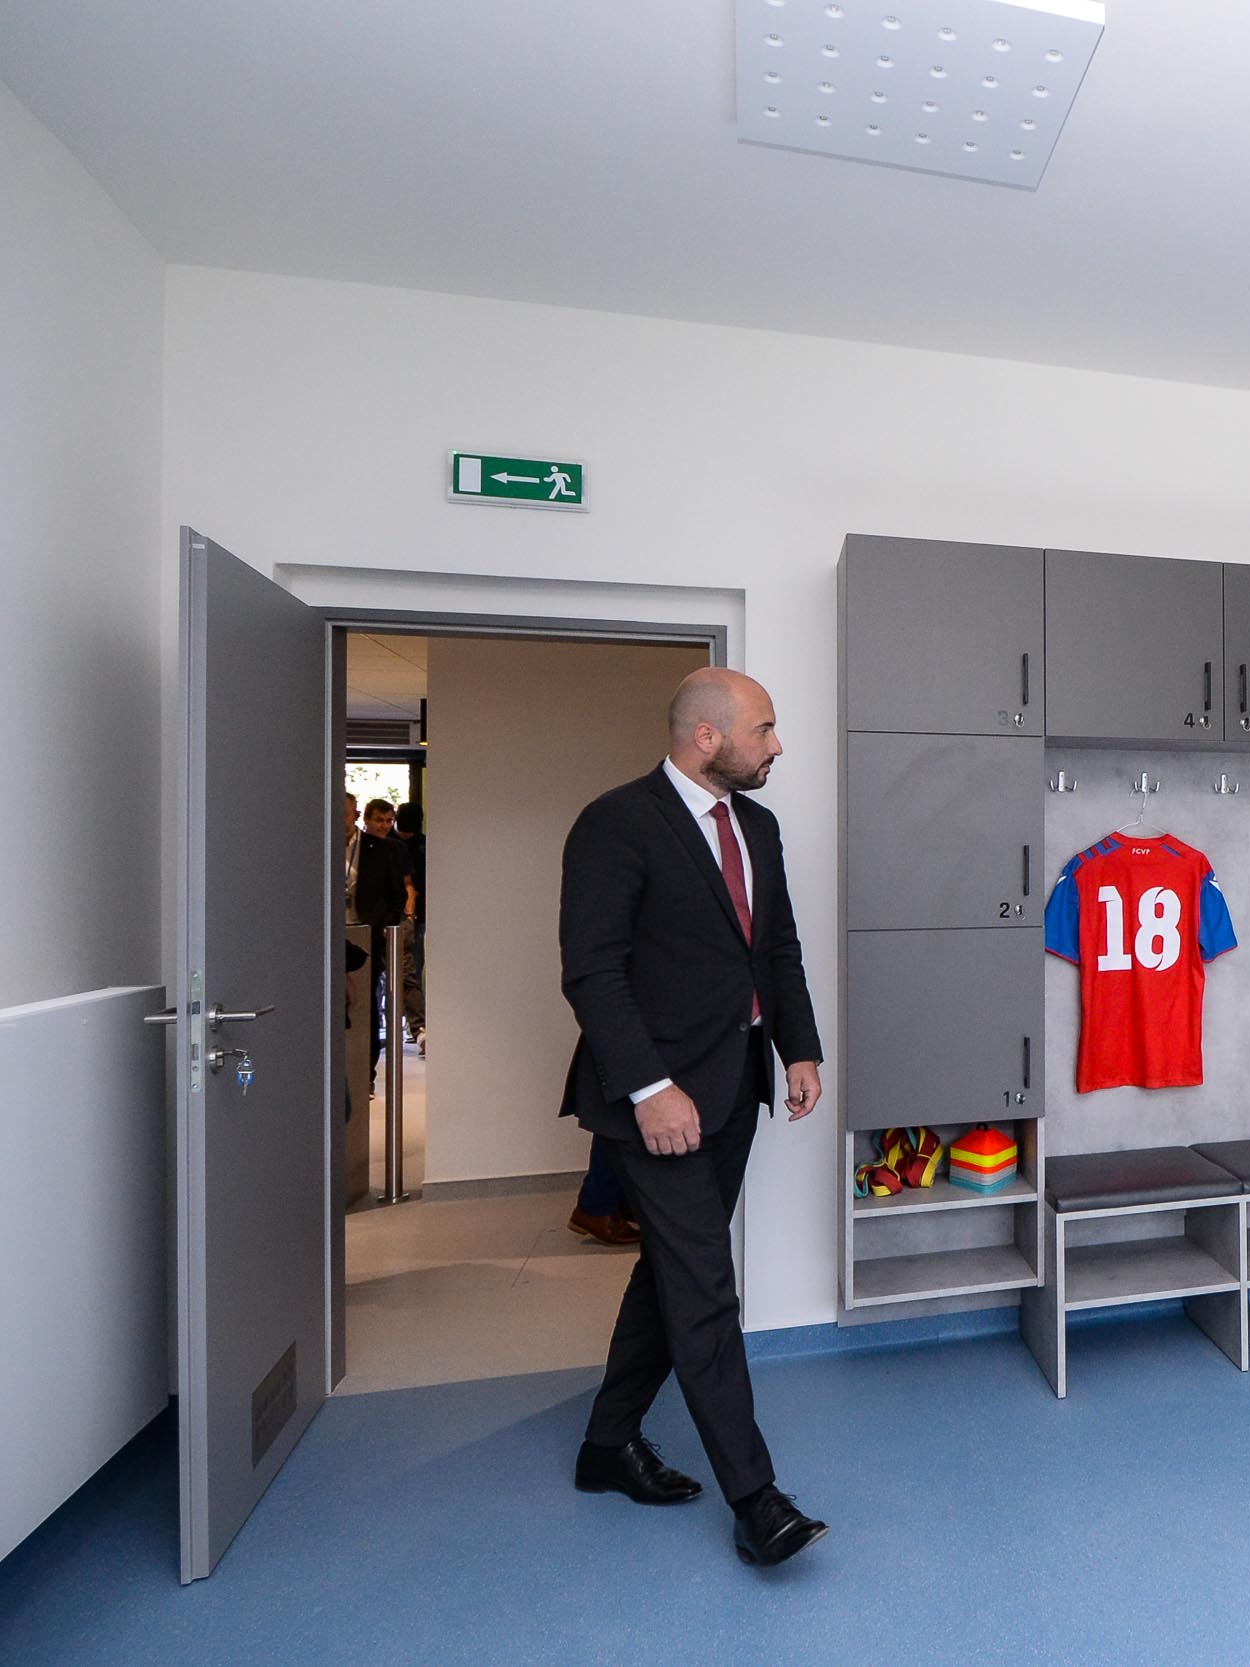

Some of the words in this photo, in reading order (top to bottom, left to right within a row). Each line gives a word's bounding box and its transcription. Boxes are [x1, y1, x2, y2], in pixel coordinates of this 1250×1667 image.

[998, 710, 1009, 727] 3
[1184, 712, 1195, 728] 4
[999, 902, 1010, 919] 2
[1097, 885, 1181, 972] 18
[1002, 1091, 1010, 1108] 1
